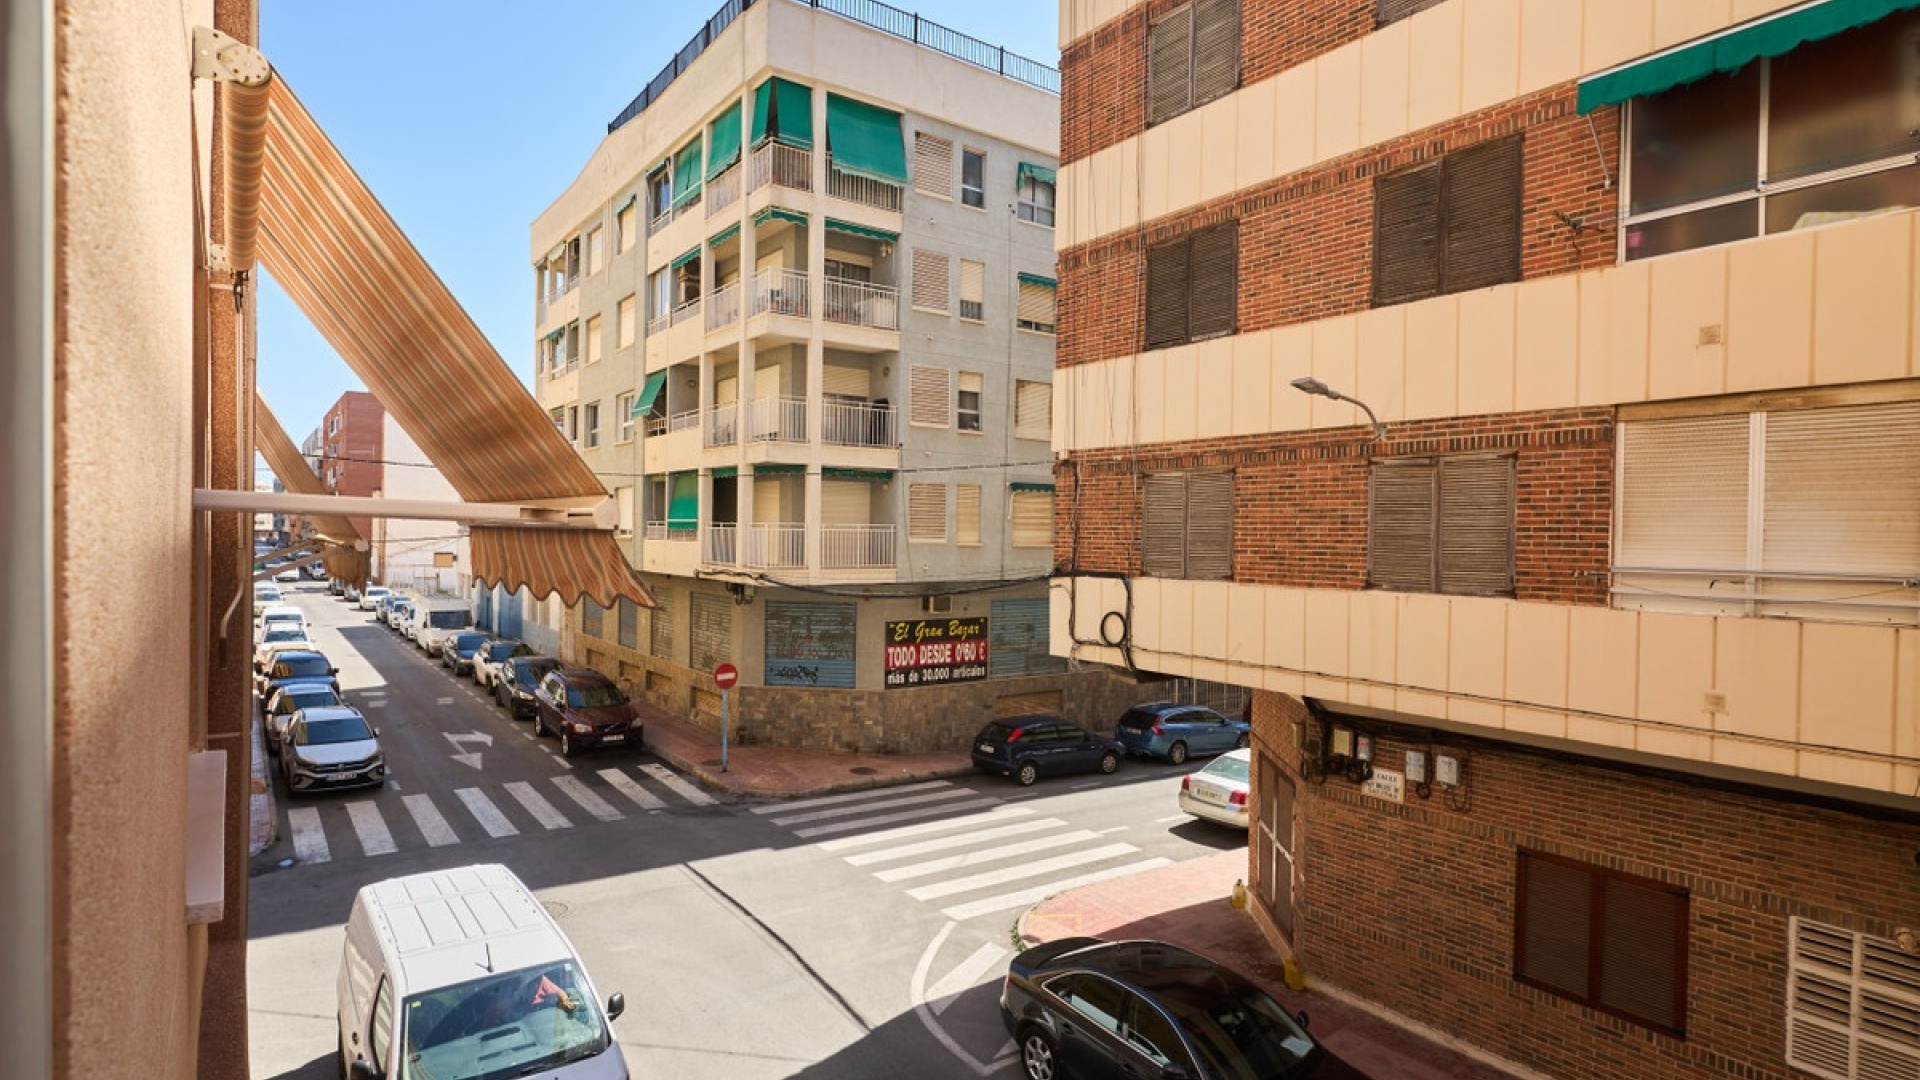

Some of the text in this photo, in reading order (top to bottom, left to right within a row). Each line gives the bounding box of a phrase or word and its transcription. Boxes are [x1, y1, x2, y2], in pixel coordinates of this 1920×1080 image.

[915, 621, 943, 643] Gran
[888, 645, 916, 667] TODO
[920, 643, 953, 665] DESDE
[909, 669, 918, 683] de
[922, 667, 949, 681] 30.000
